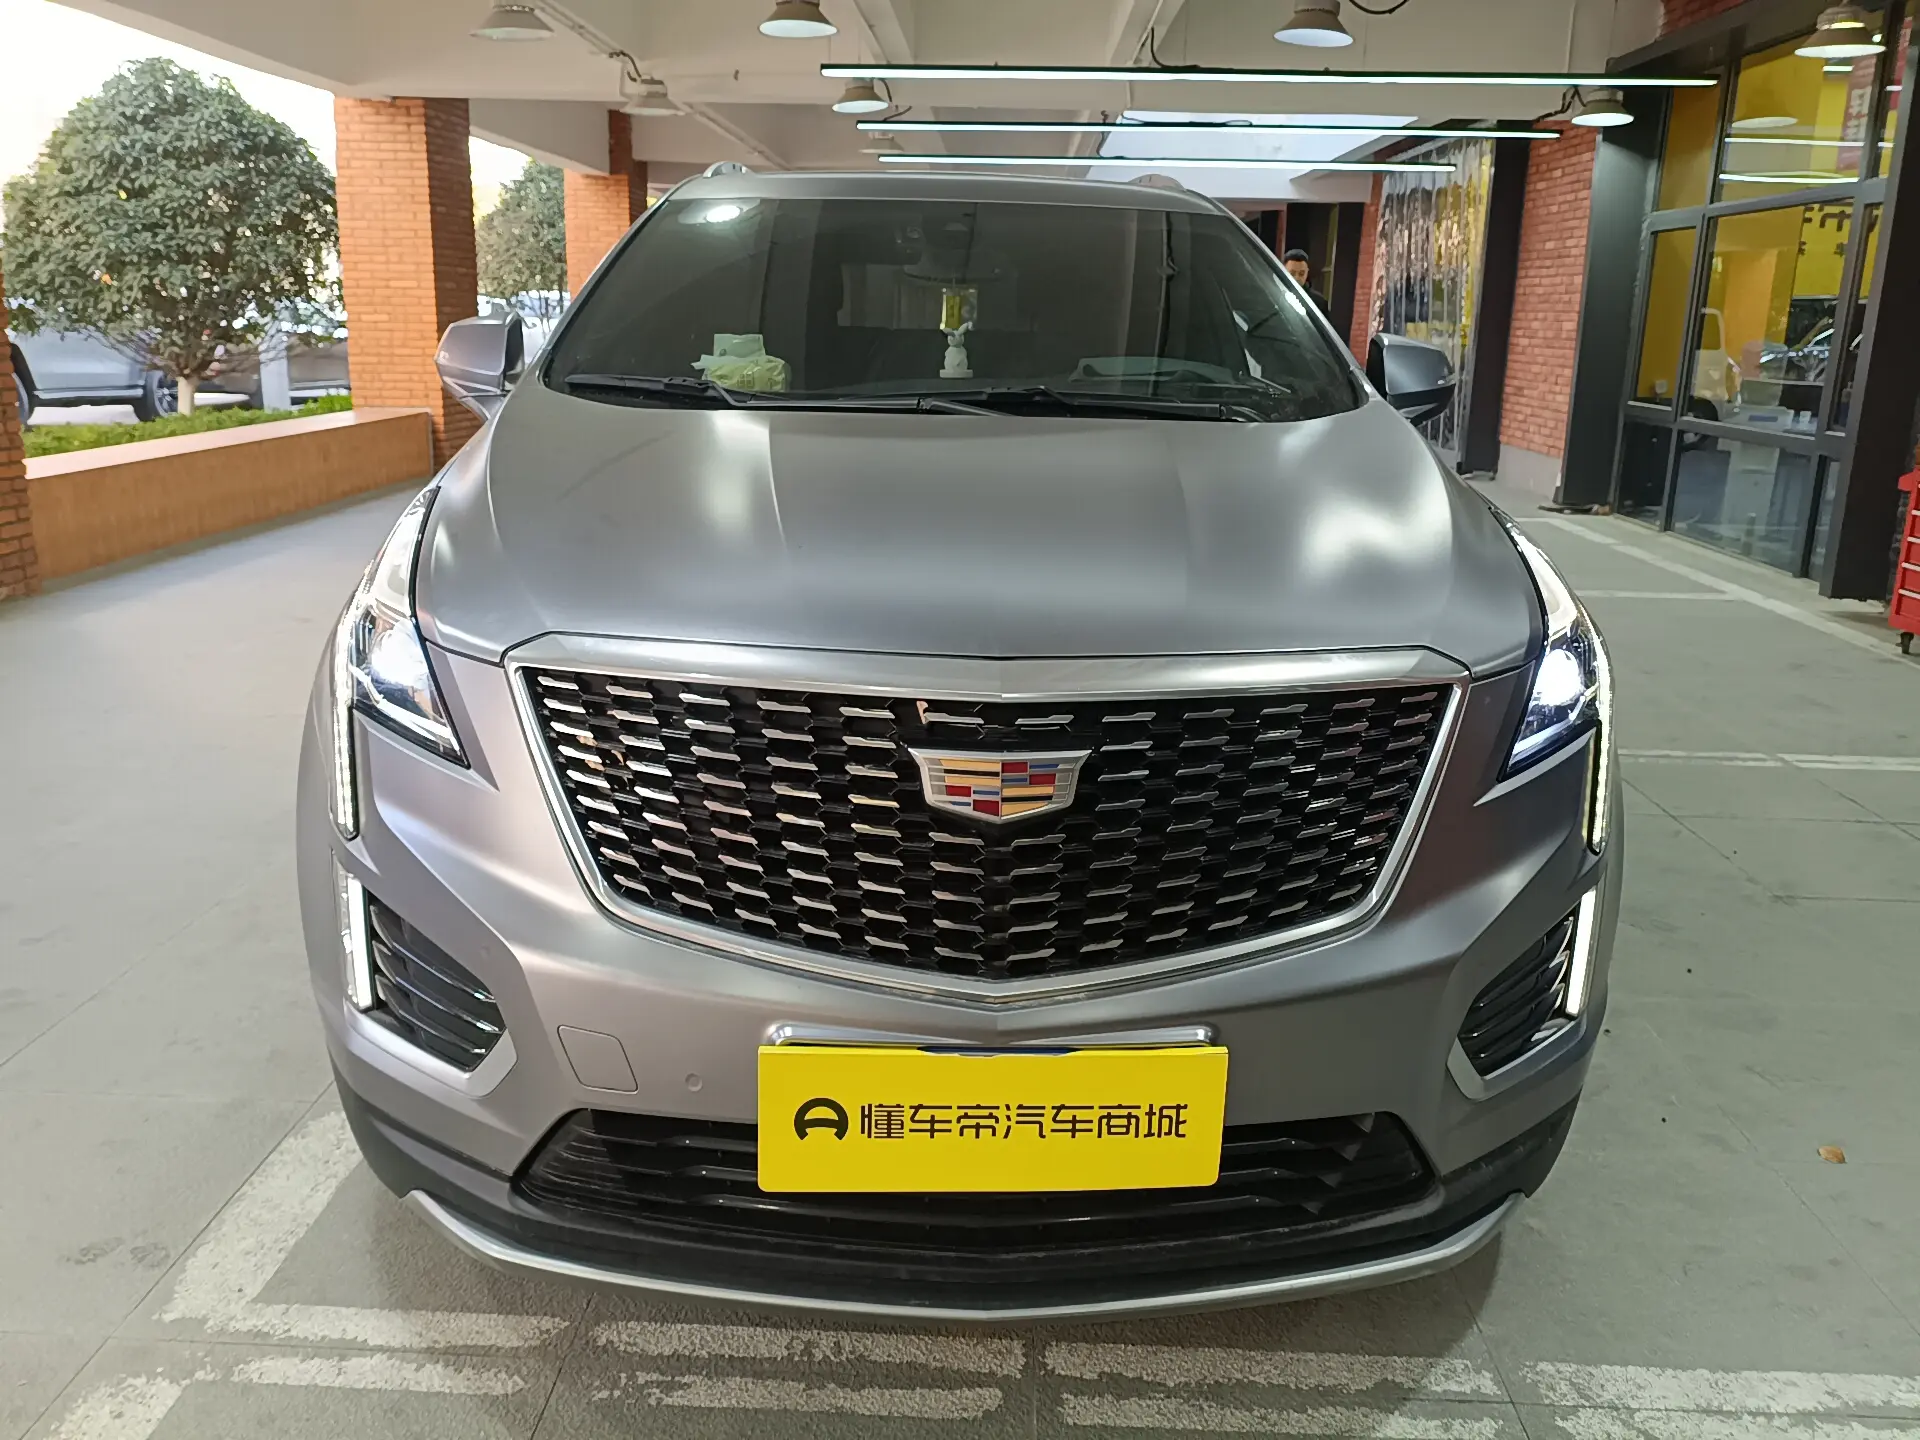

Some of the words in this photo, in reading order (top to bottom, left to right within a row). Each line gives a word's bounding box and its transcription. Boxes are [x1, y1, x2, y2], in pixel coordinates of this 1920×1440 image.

[861, 1104, 1187, 1138] 懂车帝汽车商城
